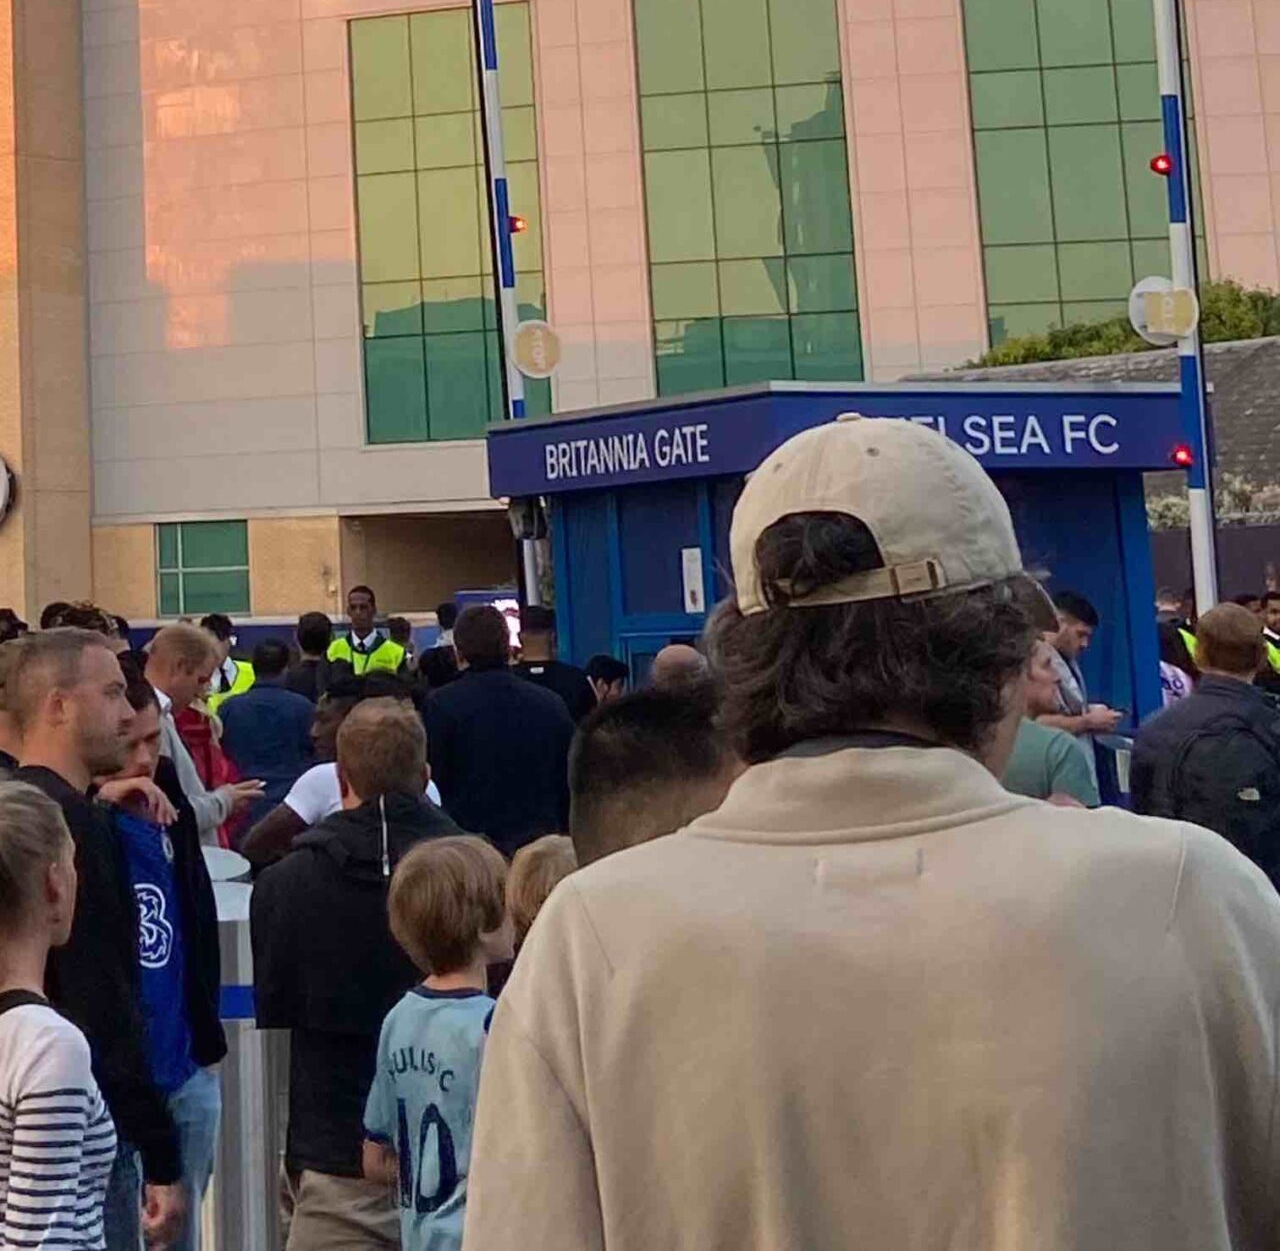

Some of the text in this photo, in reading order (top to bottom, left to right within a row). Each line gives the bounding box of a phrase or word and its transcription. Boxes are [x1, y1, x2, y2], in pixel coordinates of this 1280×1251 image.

[545, 424, 710, 479] BRITANNIA GATE
[902, 414, 1120, 455] LSEA FC
[387, 1046, 455, 1093] ULISC
[396, 1097, 458, 1213] 10
